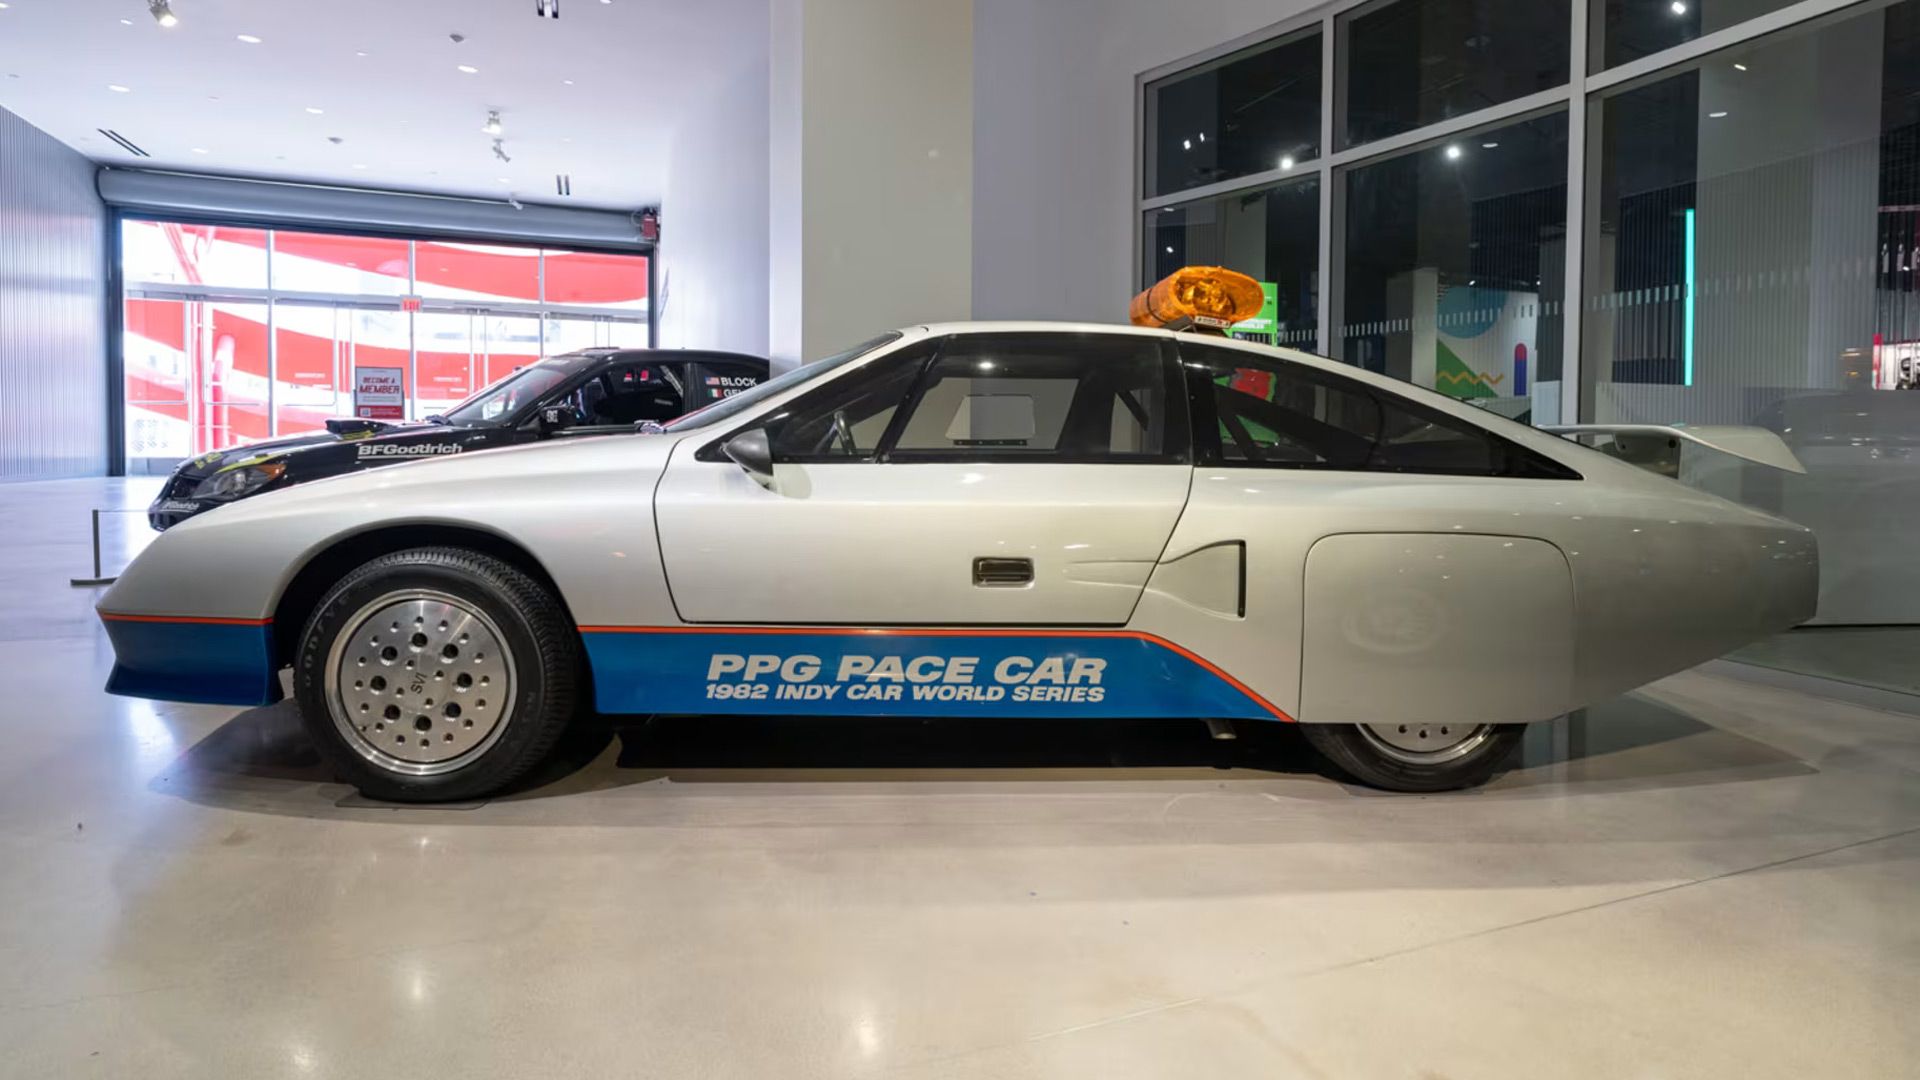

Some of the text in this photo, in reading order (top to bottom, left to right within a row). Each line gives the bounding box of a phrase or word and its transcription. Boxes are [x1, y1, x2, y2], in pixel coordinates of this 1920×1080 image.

[720, 377, 757, 387] BLOCK
[359, 385, 400, 394] MEMBER
[358, 443, 463, 455] BFGoodrich
[707, 654, 1107, 684] PPG PACE CAR
[706, 683, 1106, 702] 1982 INDY CAR WORLD SERIES
